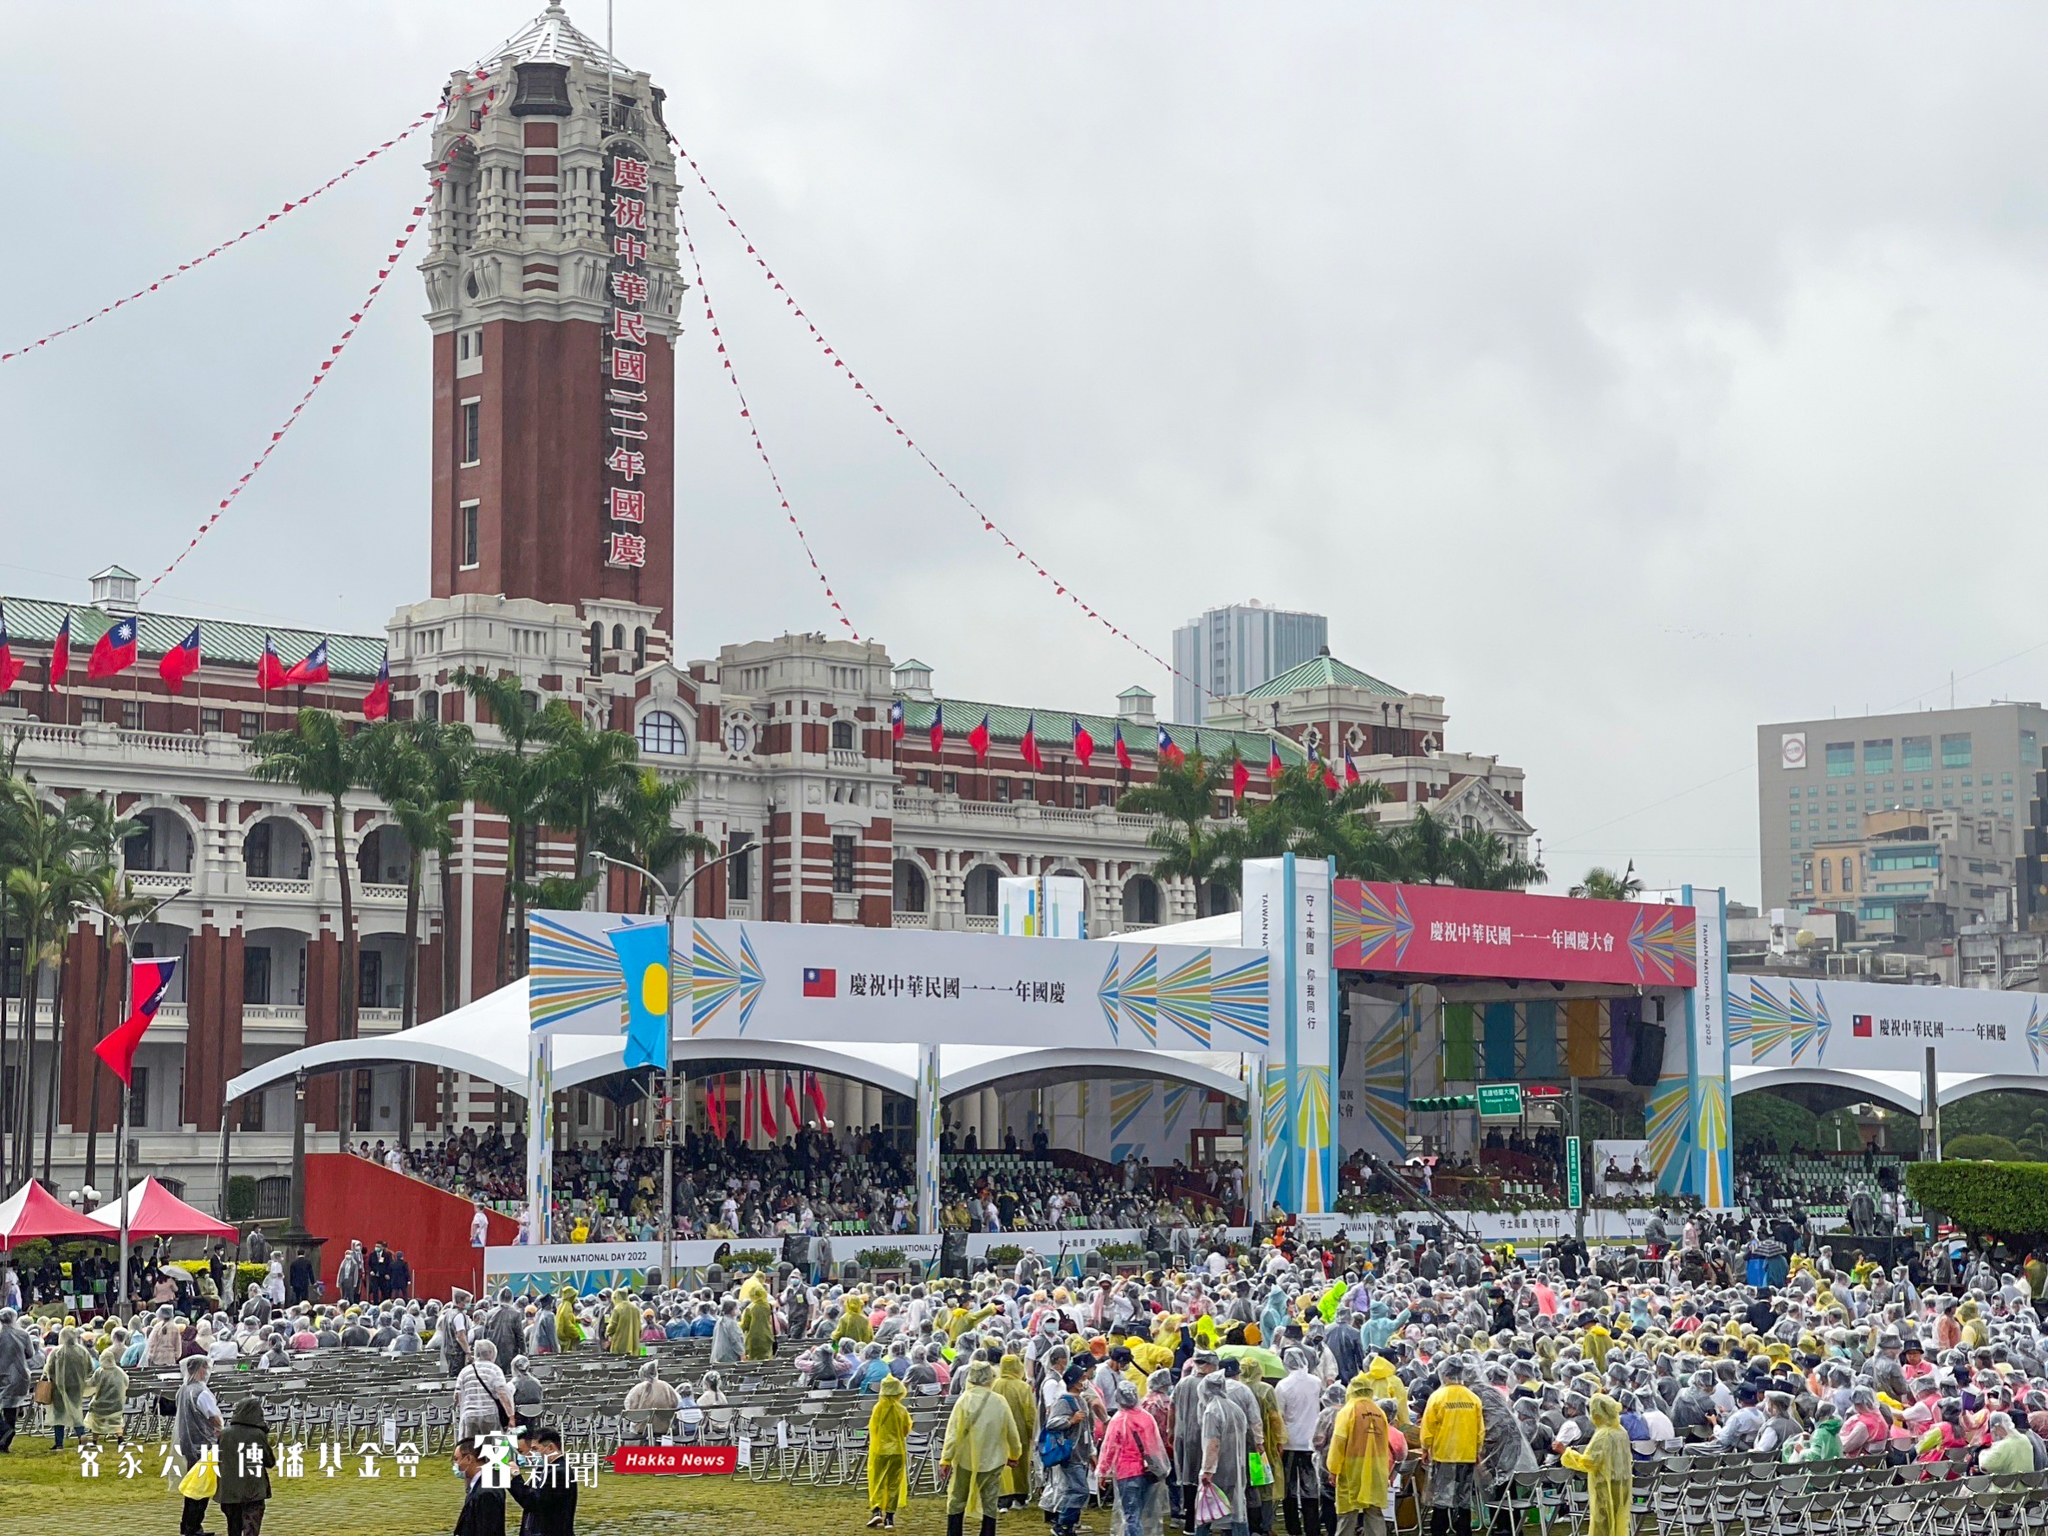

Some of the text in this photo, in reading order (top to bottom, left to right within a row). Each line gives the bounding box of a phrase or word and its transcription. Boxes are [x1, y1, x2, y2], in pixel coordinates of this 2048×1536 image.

[610, 156, 650, 568] 慶祝中華民國一一一年國慶
[1430, 921, 1615, 952] 慶祝中華民國一一一年國慶大會
[1306, 895, 1316, 1030] 守土衛國 你我同行
[849, 973, 1065, 1004] 慶祝中華民國一一一年國慶
[1879, 1018, 2007, 1041] 慶祝中華民國一一一年國慶
[538, 1251, 647, 1265] TAIWAN NATIONAL DAY 2022
